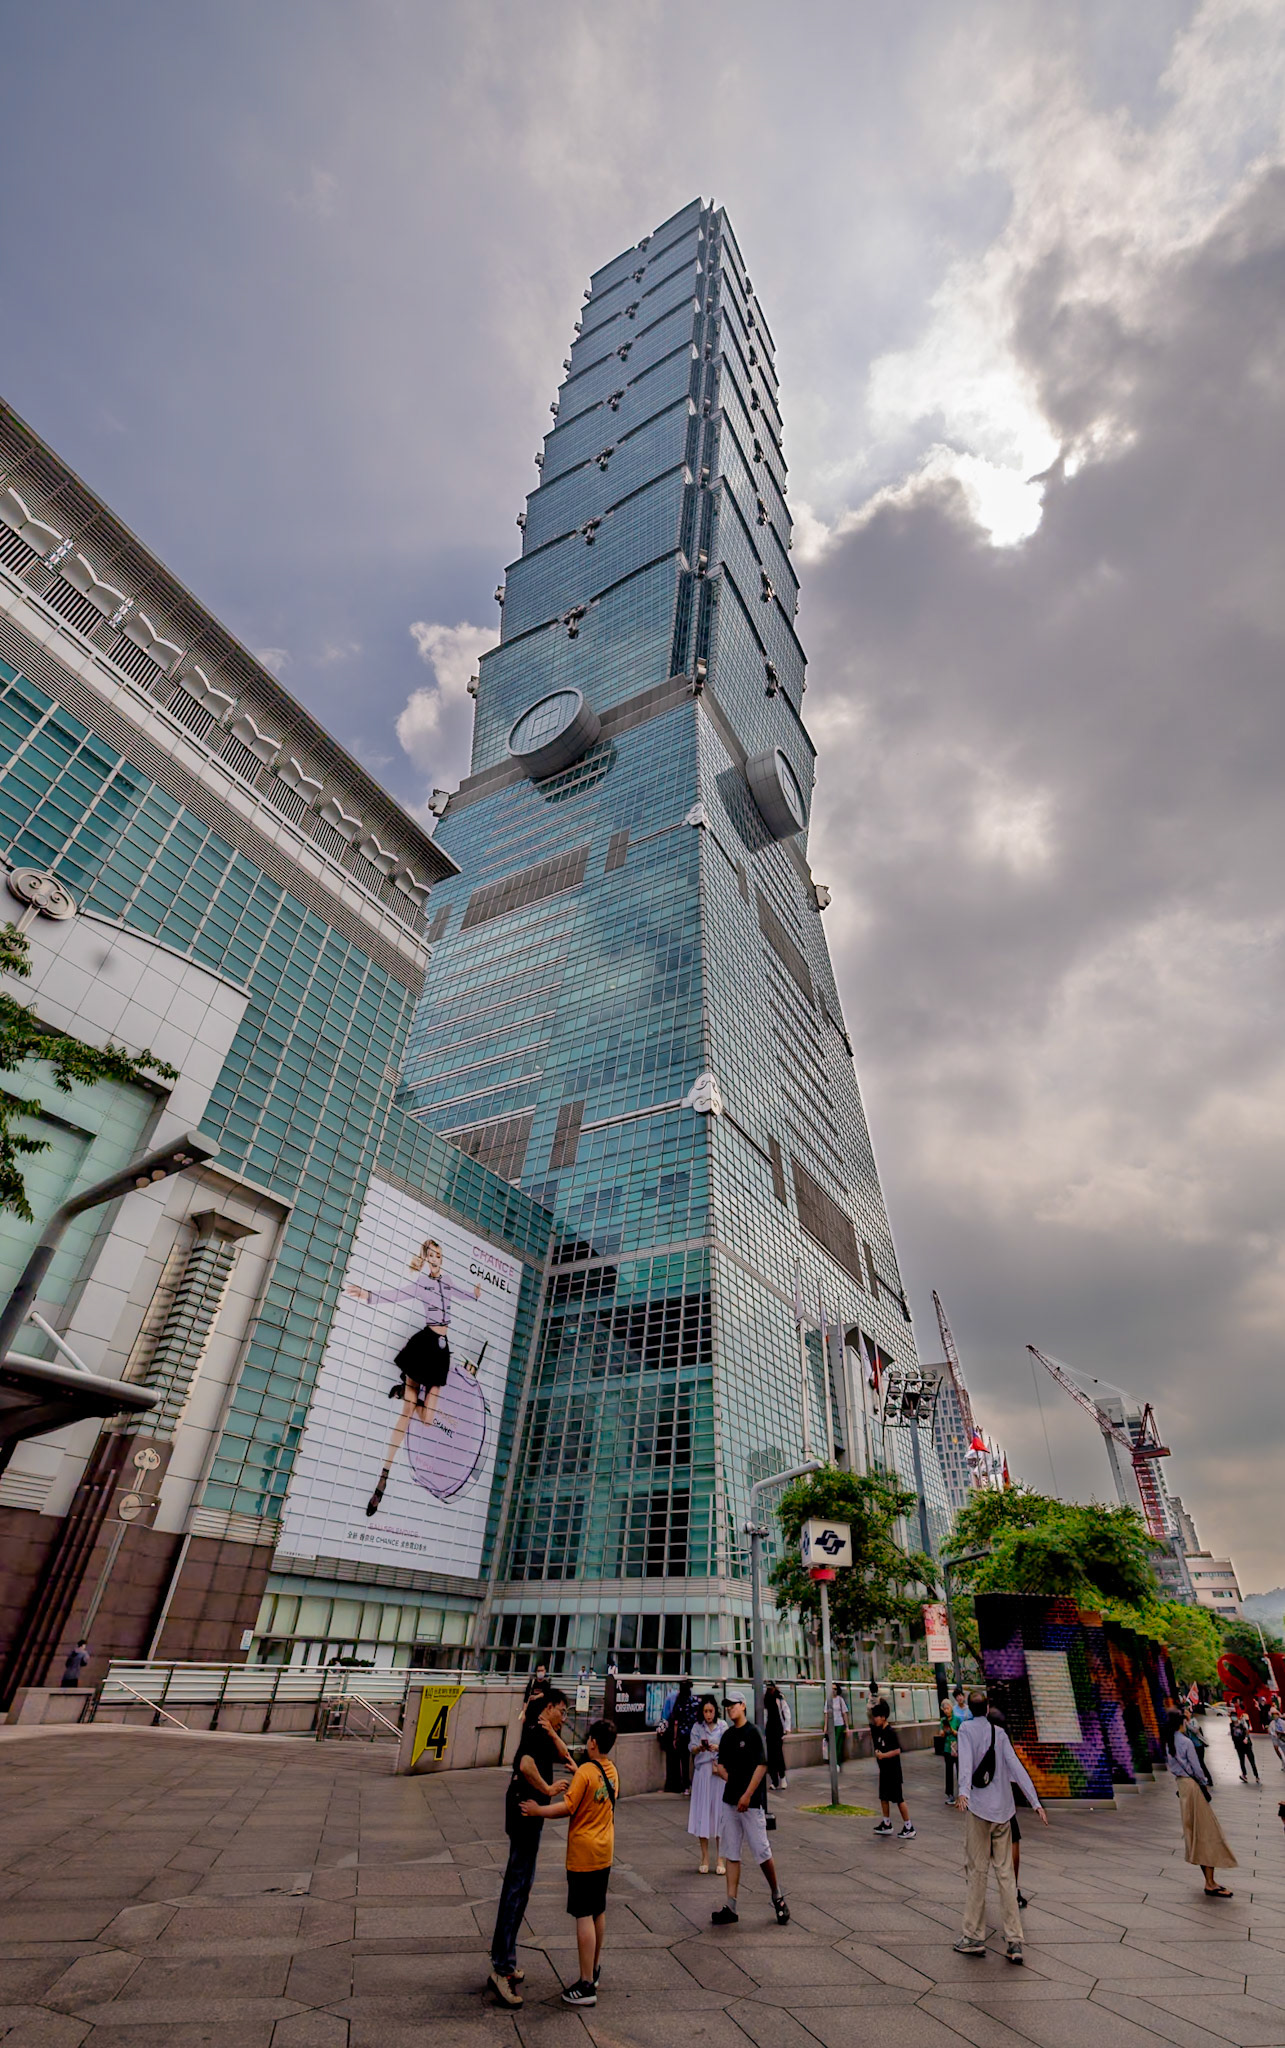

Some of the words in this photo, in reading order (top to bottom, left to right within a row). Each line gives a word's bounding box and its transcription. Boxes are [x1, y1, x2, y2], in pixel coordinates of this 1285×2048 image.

[472, 1246, 515, 1277] CHANCE
[469, 1263, 512, 1294] CHANEL
[433, 1418, 453, 1438] CHANEL
[376, 1536, 400, 1547] CHANCE
[615, 1703, 646, 1713] OBSERVATORY
[426, 1705, 449, 1759] 4
